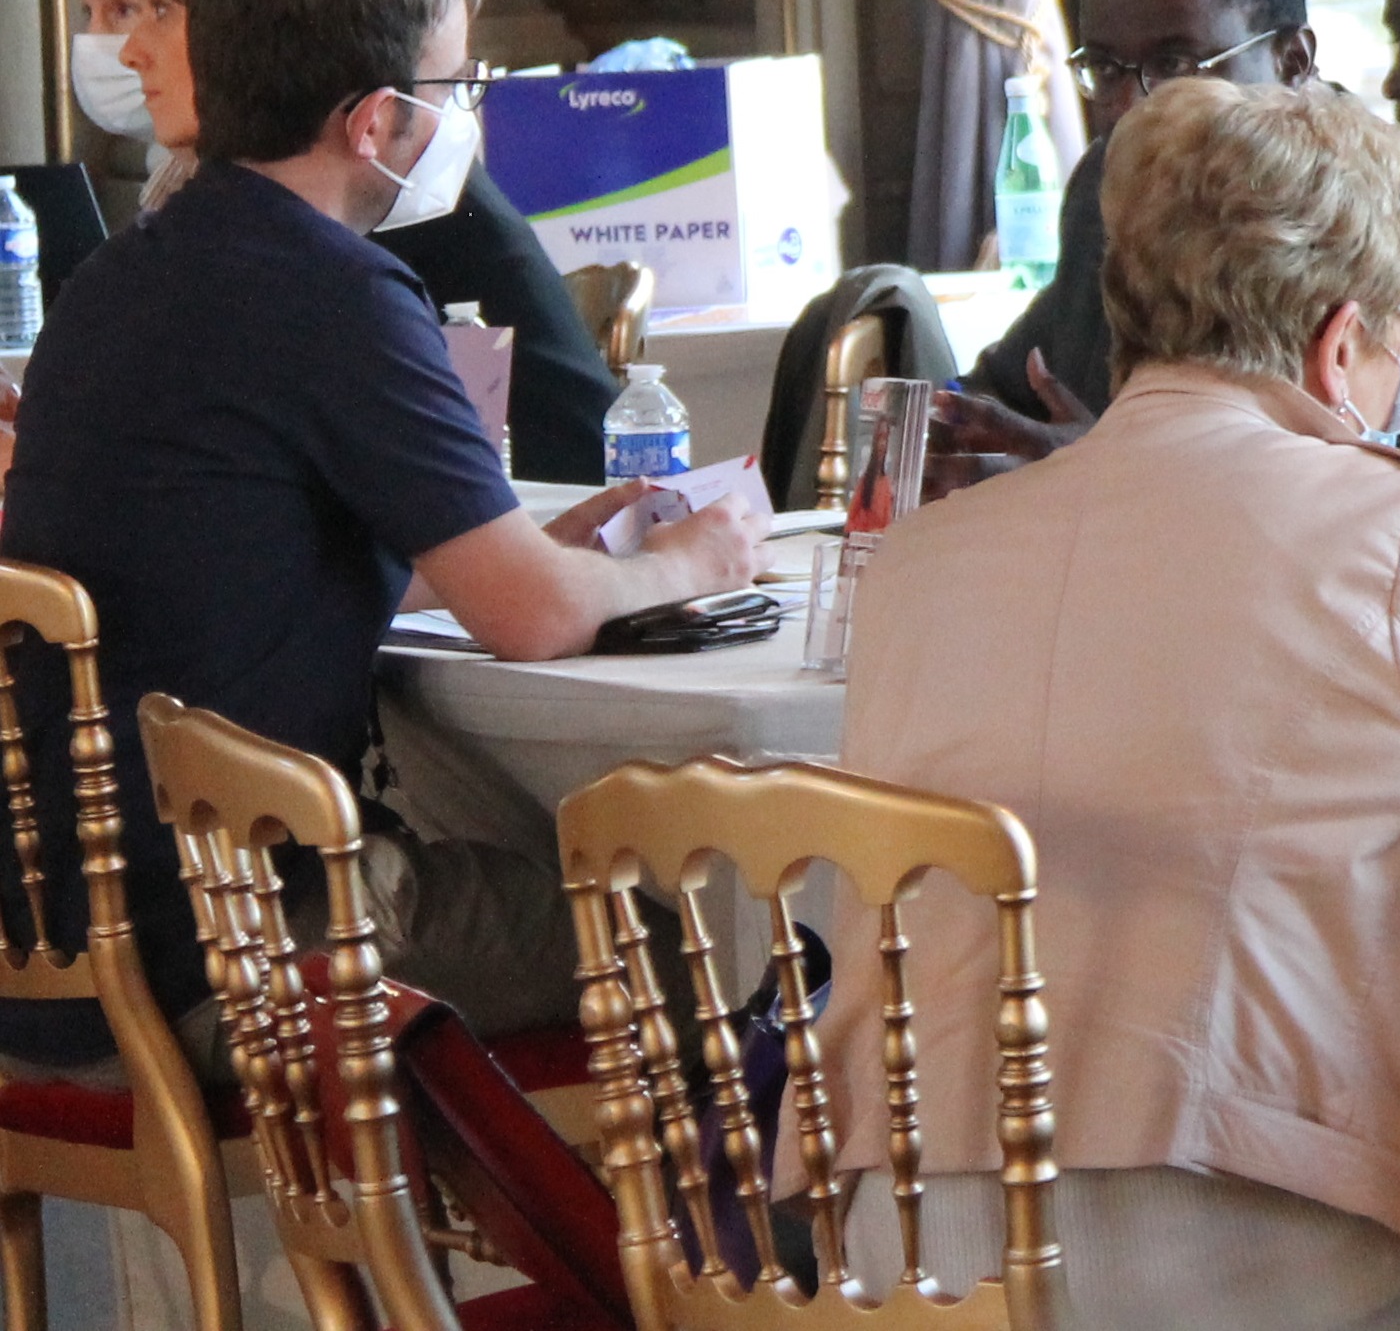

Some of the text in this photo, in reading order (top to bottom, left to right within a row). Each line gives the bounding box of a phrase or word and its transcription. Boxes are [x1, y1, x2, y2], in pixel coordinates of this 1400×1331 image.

[568, 89, 637, 111] Lyreco
[570, 221, 731, 244] WHITE PAPER
